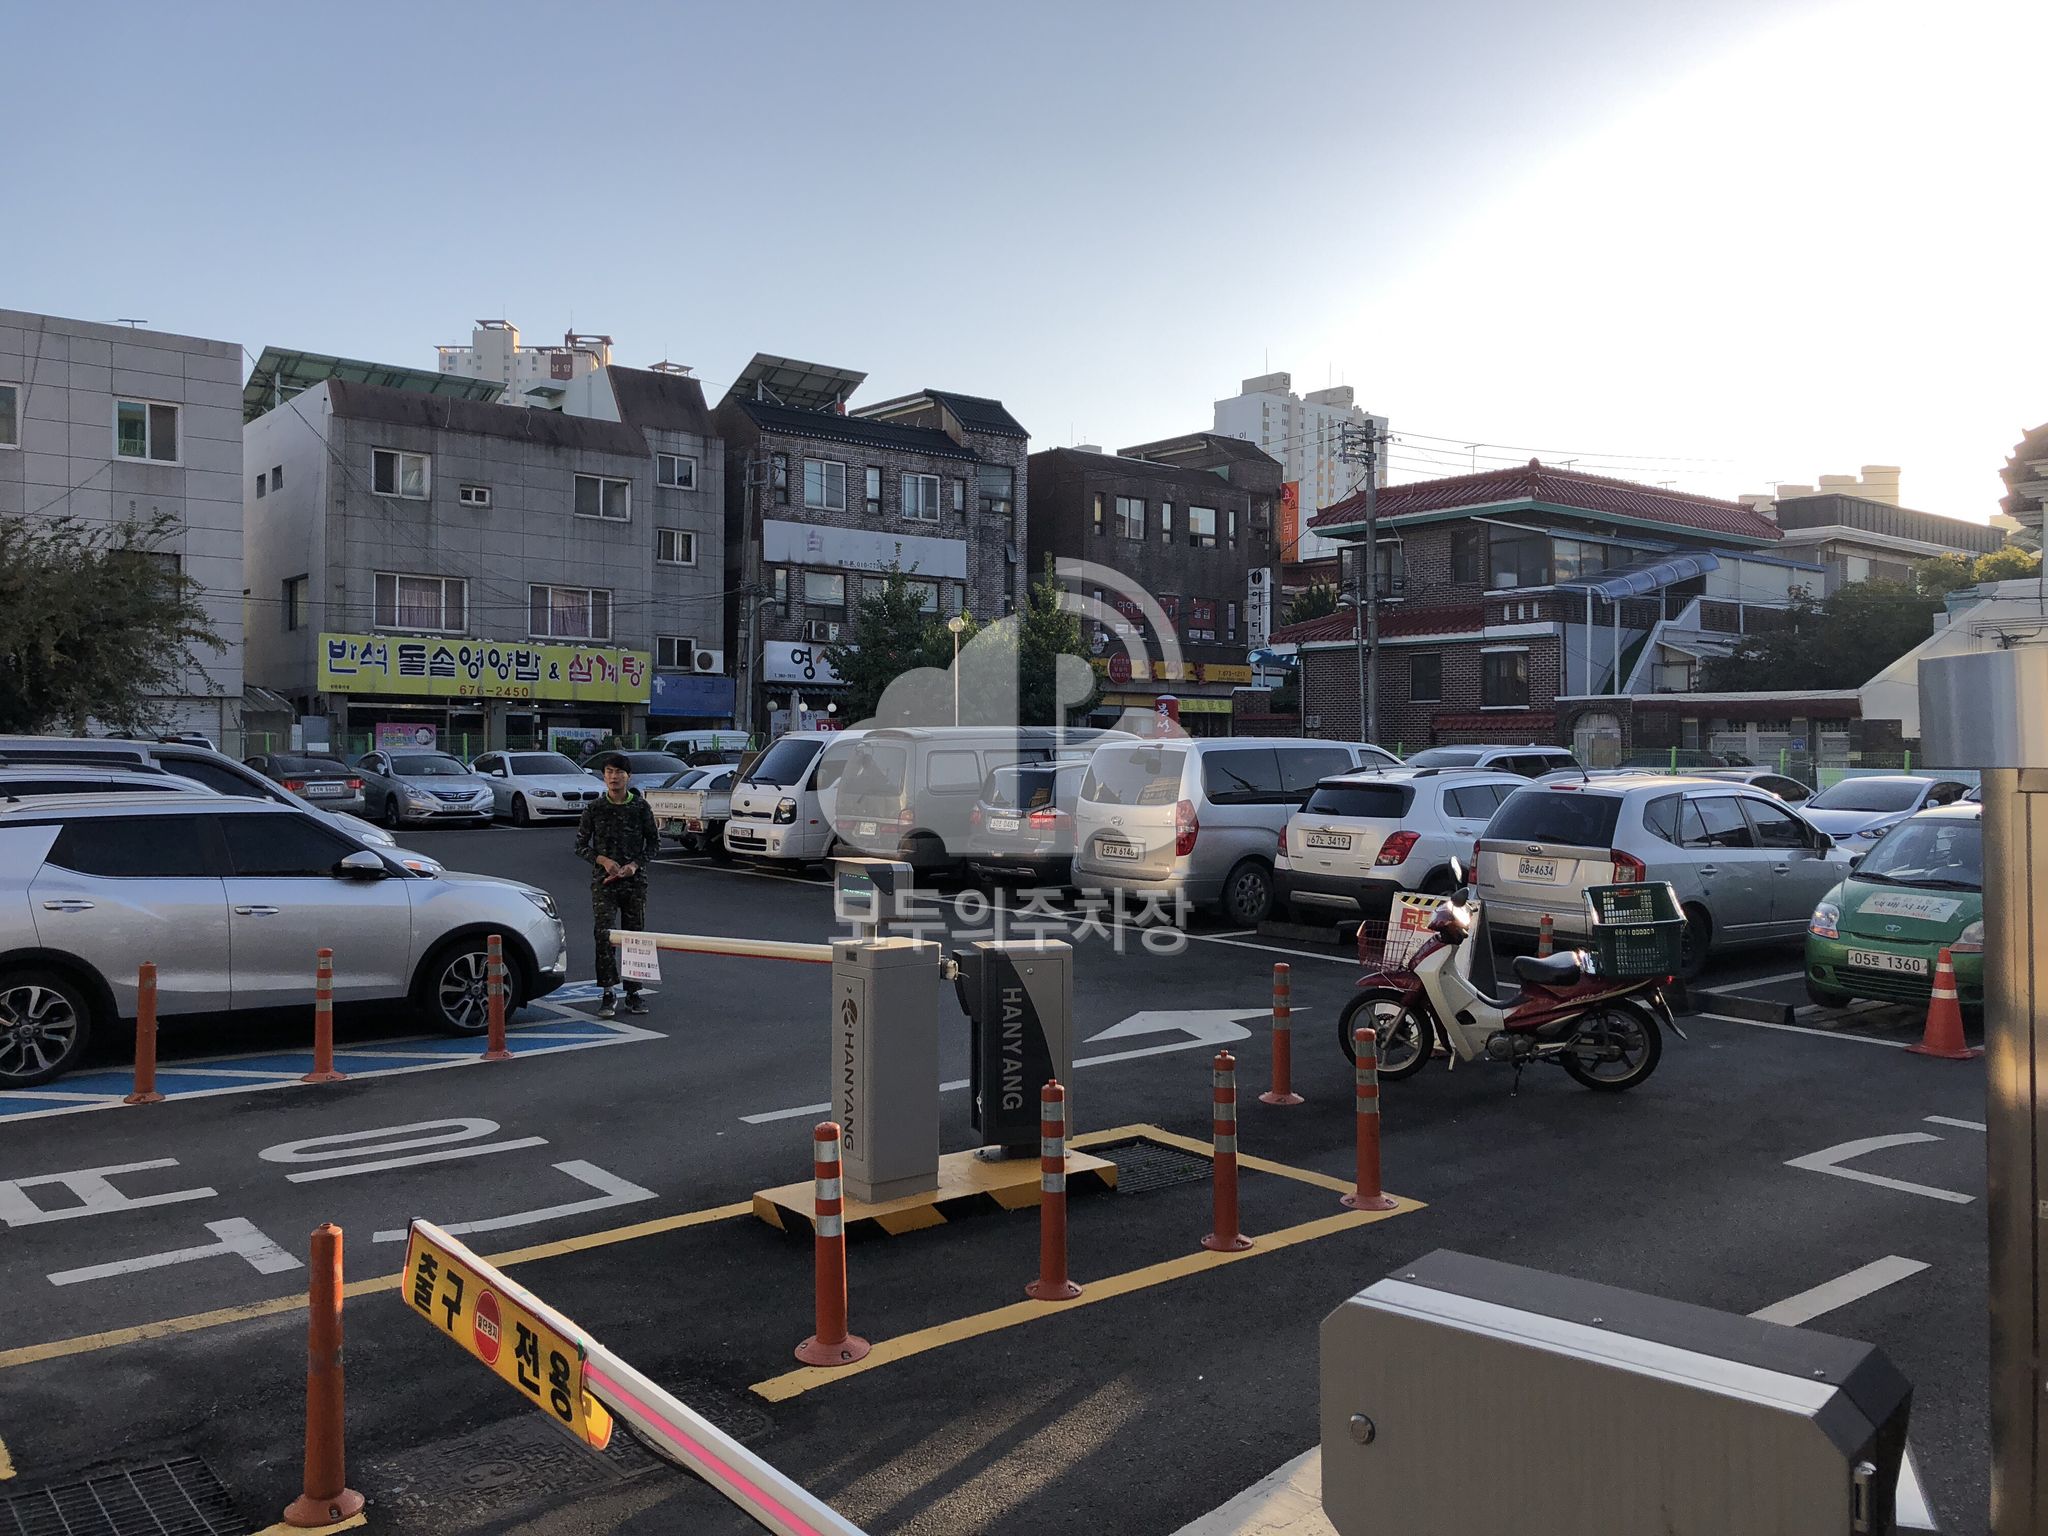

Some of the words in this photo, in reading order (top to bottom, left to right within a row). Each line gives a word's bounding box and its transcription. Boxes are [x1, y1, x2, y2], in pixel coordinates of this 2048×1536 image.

[328, 640, 388, 675] 반석
[398, 643, 540, 680] 돌솥영양밥
[549, 662, 560, 680] &
[569, 654, 645, 687] 삼계탕
[459, 684, 529, 697] 676-2450
[1327, 836, 1347, 847] 3419
[1854, 952, 1880, 967] 05로
[1886, 956, 1921, 972] 1360
[1002, 987, 1023, 1111] HANYANG
[843, 1032, 855, 1151] HANYANG
[414, 1252, 464, 1332] 출구
[515, 1321, 573, 1422] 전용
